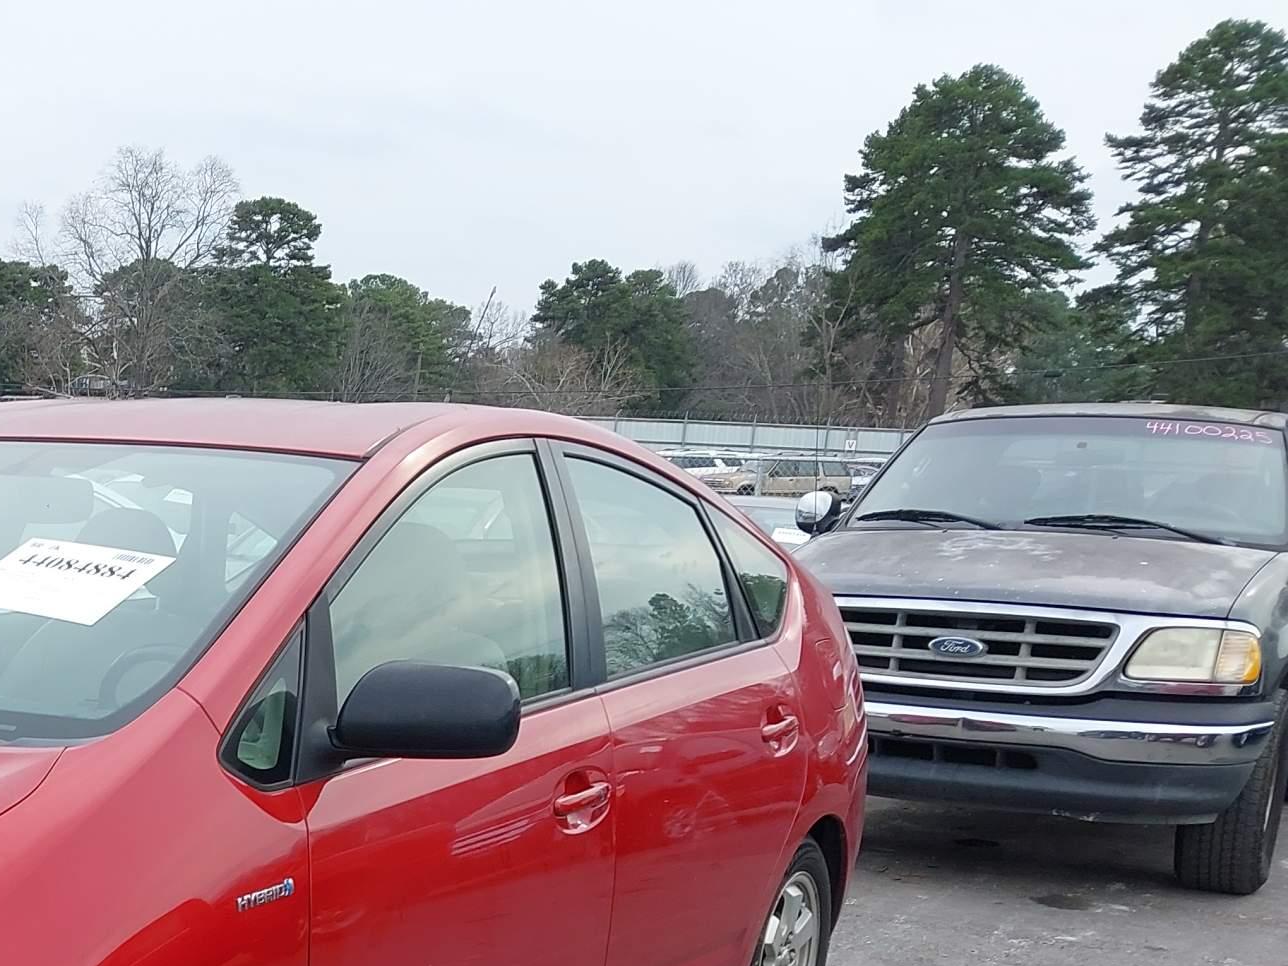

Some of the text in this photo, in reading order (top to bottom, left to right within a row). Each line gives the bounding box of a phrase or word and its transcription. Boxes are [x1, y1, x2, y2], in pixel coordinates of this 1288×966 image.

[1145, 421, 1274, 445] 44100225
[18, 553, 137, 580] 44084884
[940, 640, 972, 653] Ford
[236, 884, 286, 912] HYBRID
